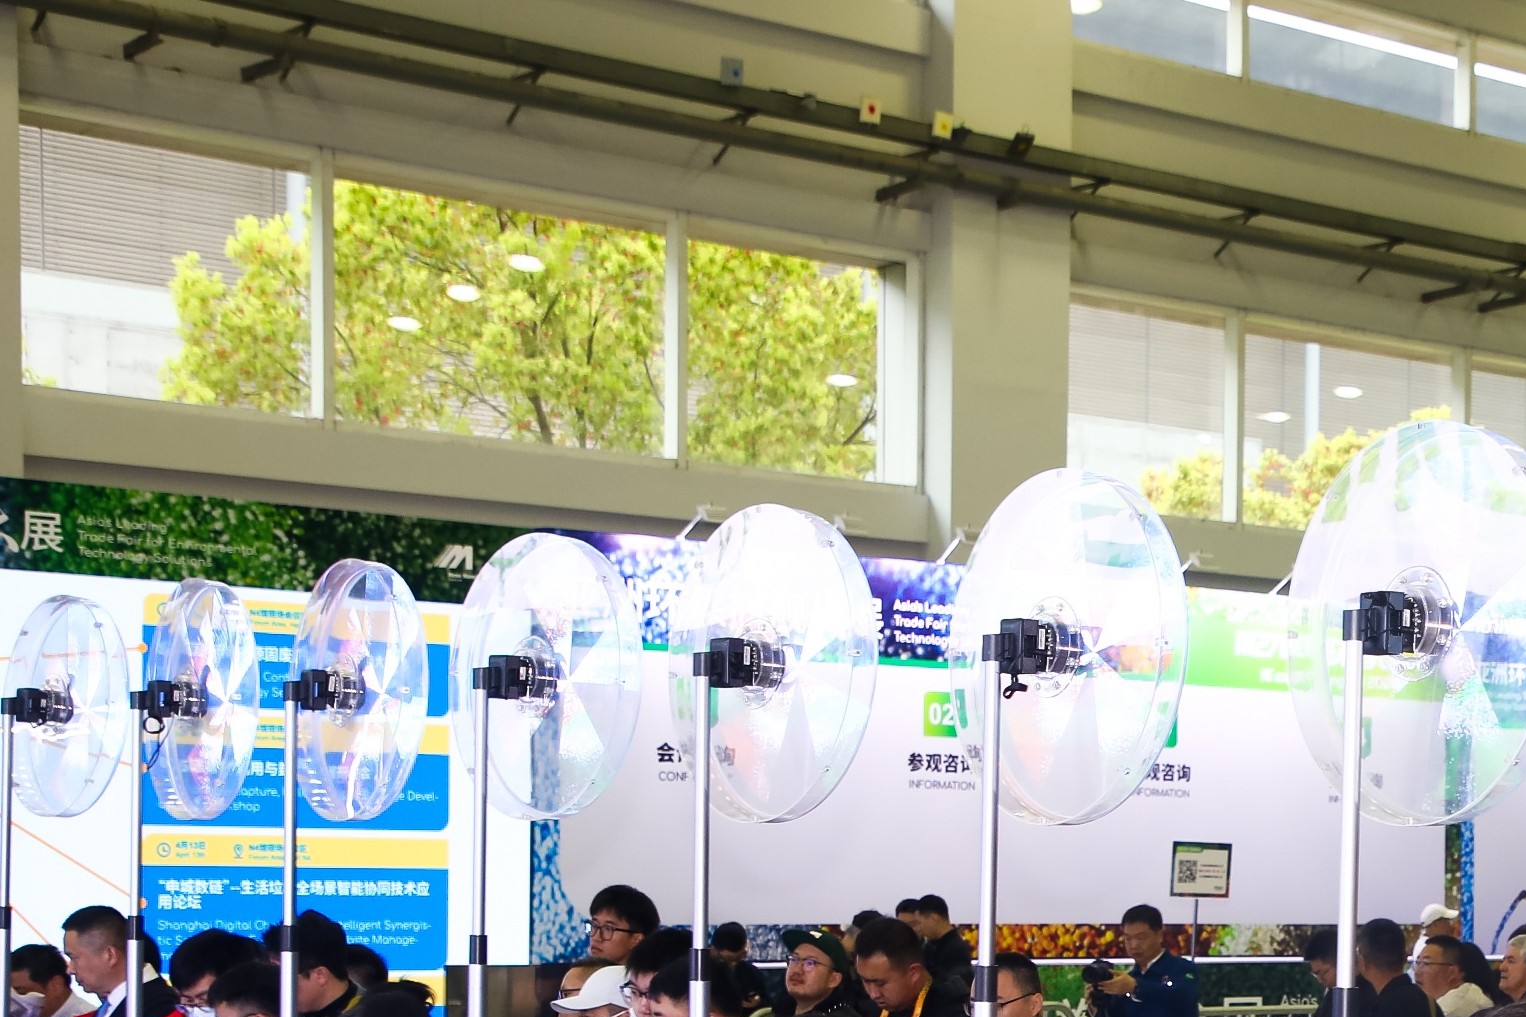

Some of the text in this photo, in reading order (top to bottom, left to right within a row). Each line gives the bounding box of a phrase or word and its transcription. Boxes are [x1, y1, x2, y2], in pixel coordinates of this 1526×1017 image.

[77, 530, 258, 557] Trade Fair for Environmental
[78, 546, 213, 568] Technology Solutions
[893, 613, 924, 629] Trade
[928, 702, 956, 726] 02
[908, 779, 976, 791] INFORMATION
[157, 894, 202, 911] 用论坛
